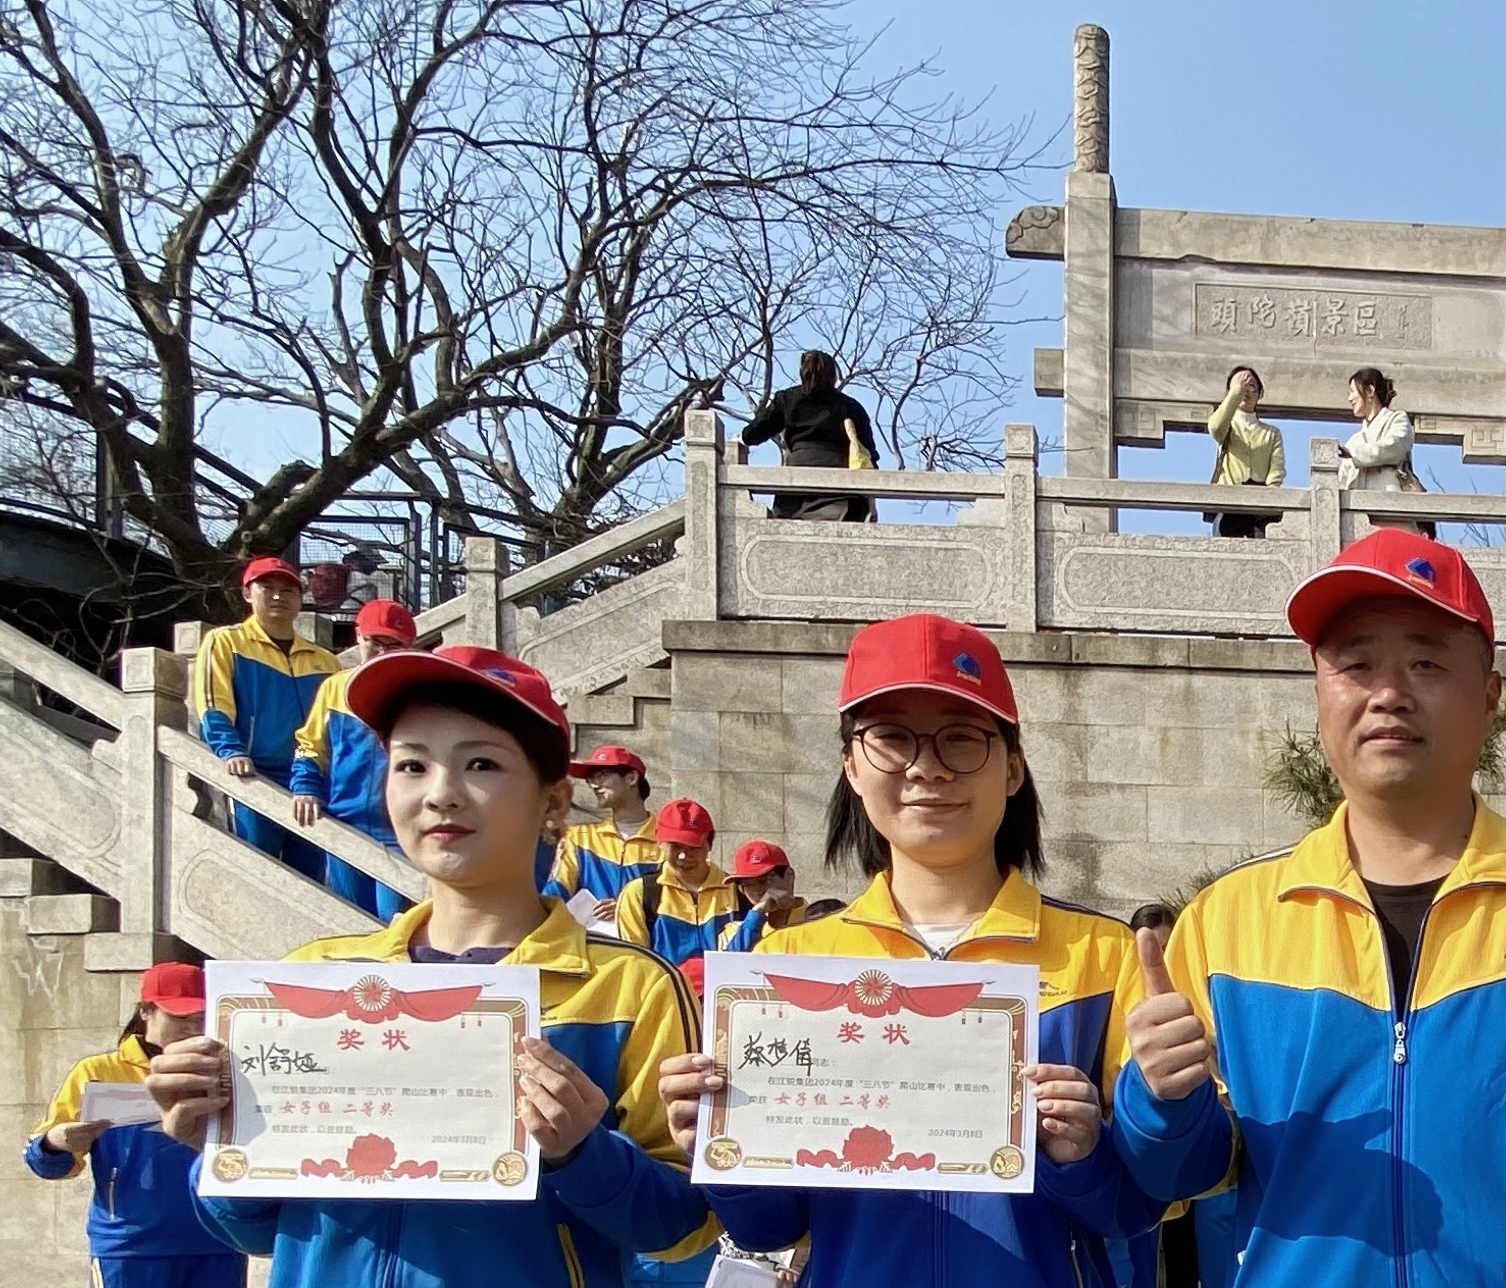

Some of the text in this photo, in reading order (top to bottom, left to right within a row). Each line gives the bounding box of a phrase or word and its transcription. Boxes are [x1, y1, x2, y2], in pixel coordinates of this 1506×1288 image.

[337, 1029, 410, 1051] 奖状
[837, 1022, 910, 1045] 奖状
[343, 1101, 394, 1117] 二等奖
[839, 1094, 891, 1110] 二等奖
